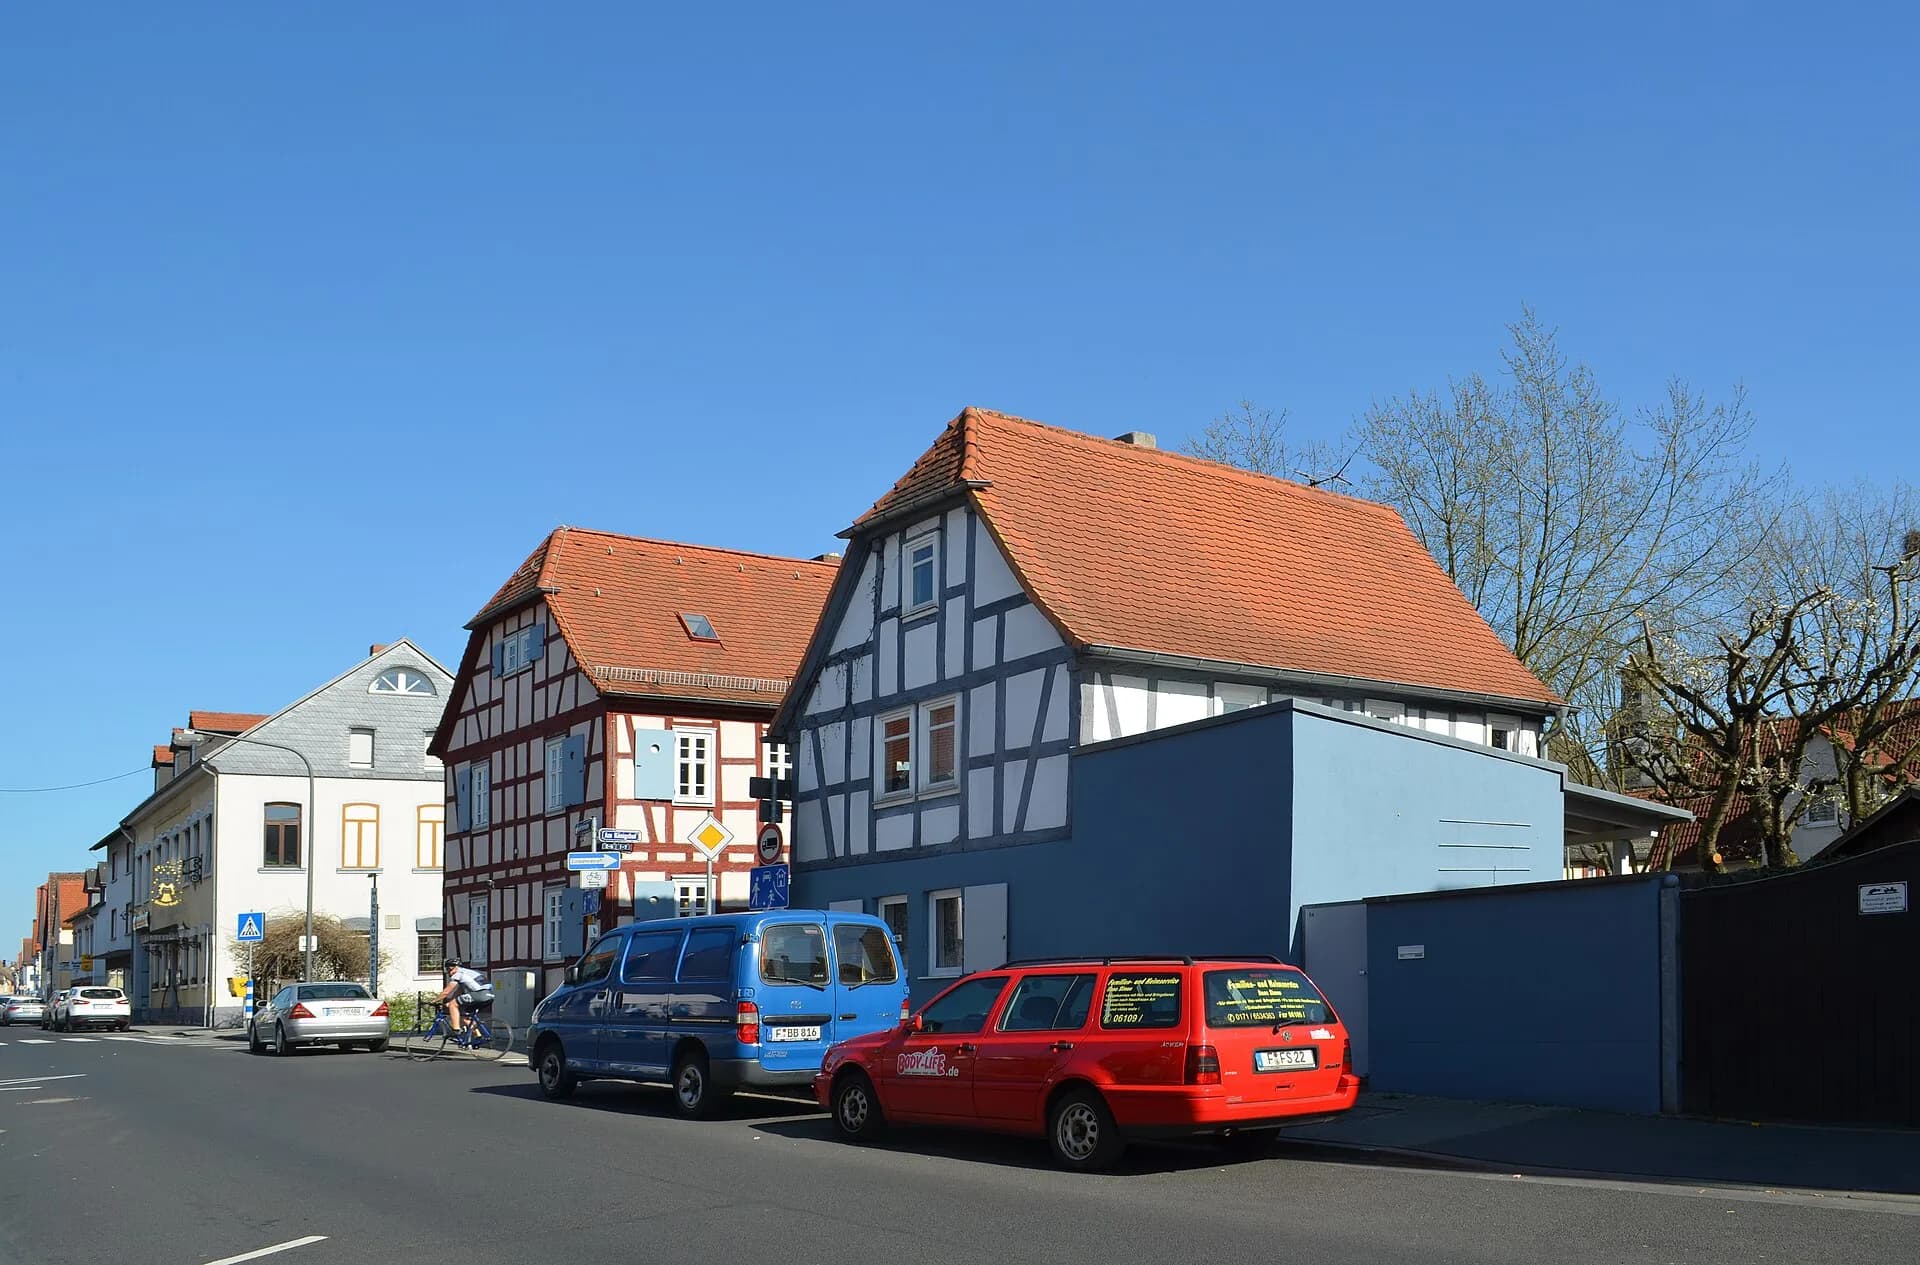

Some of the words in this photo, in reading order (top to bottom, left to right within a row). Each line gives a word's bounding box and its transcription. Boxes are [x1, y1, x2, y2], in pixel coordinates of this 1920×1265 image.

[1113, 1014, 1138, 1023] 06109
[787, 1028, 799, 1038] BB
[800, 1028, 817, 1037] 816
